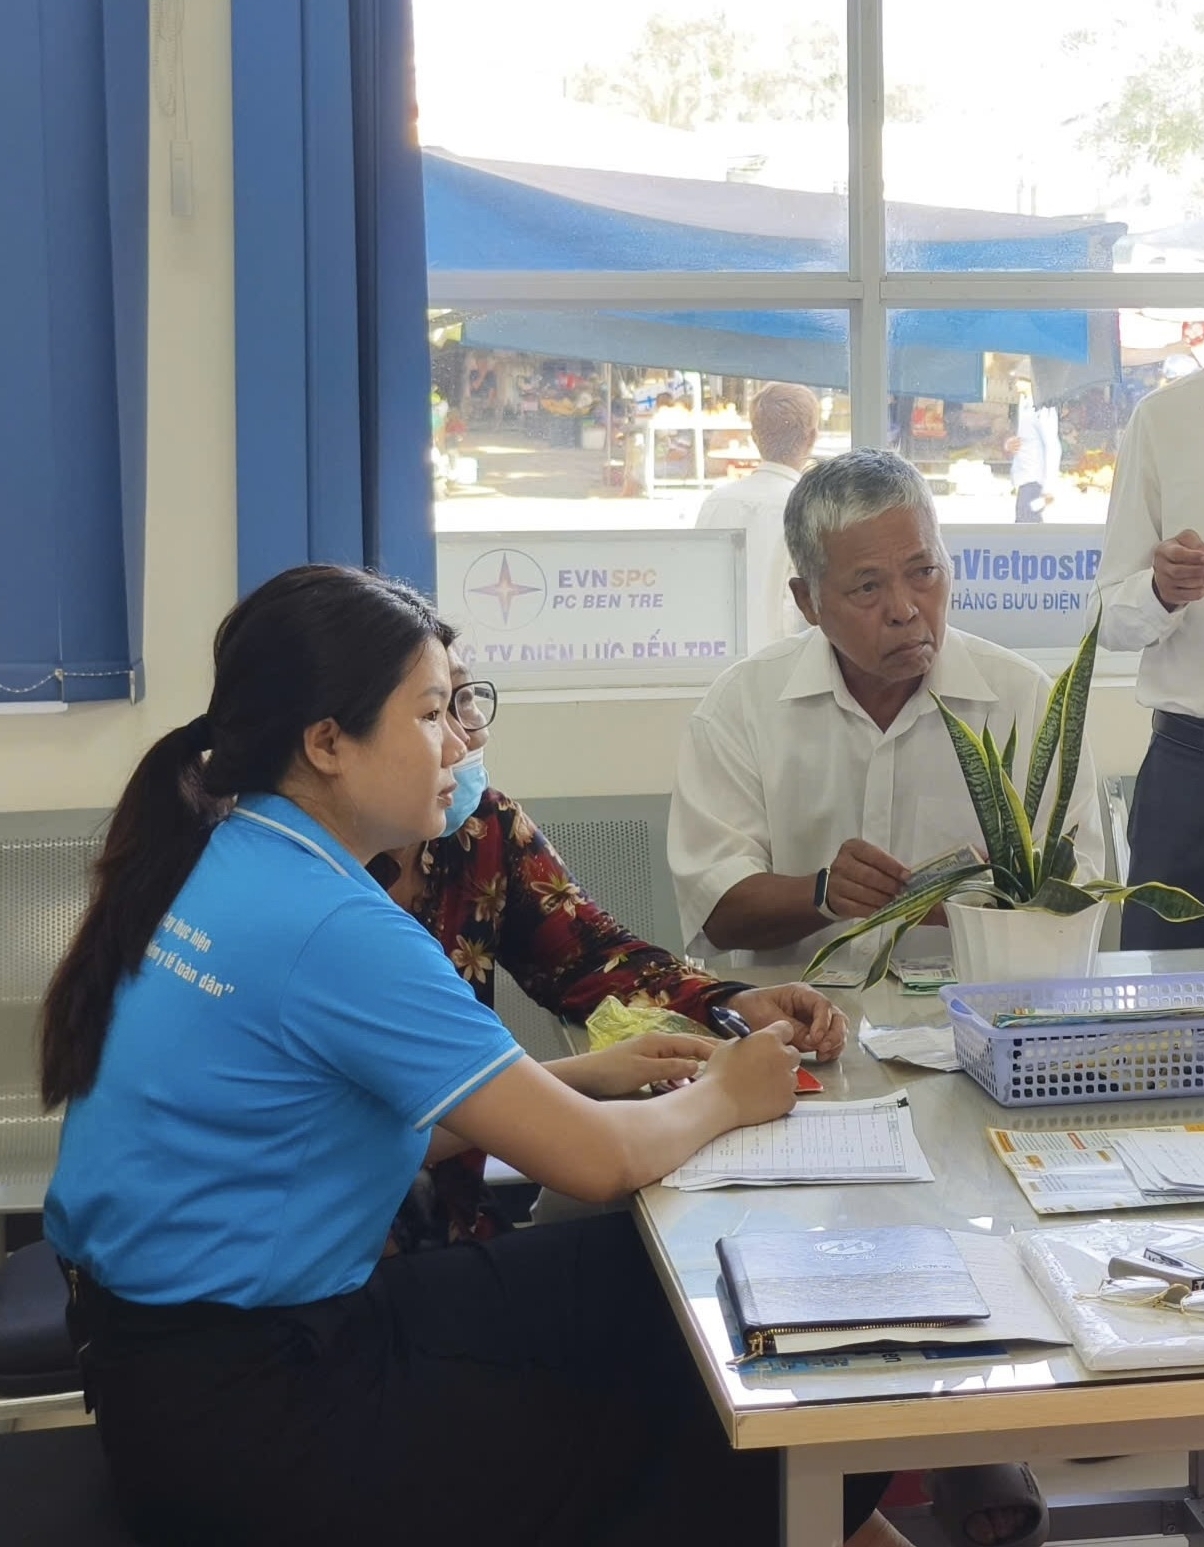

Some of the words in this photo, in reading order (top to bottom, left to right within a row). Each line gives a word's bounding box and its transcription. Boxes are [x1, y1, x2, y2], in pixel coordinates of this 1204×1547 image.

[558, 569, 657, 589] EVNSPC
[552, 594, 577, 609] PC
[583, 594, 621, 609] BEN
[630, 593, 664, 609] TRE
[951, 588, 997, 610] HÀNG
[1003, 592, 1038, 610] BƯU
[1043, 589, 1080, 614] ĐIỆN
[190, 927, 212, 953] hiện
[174, 957, 198, 984] toàn
